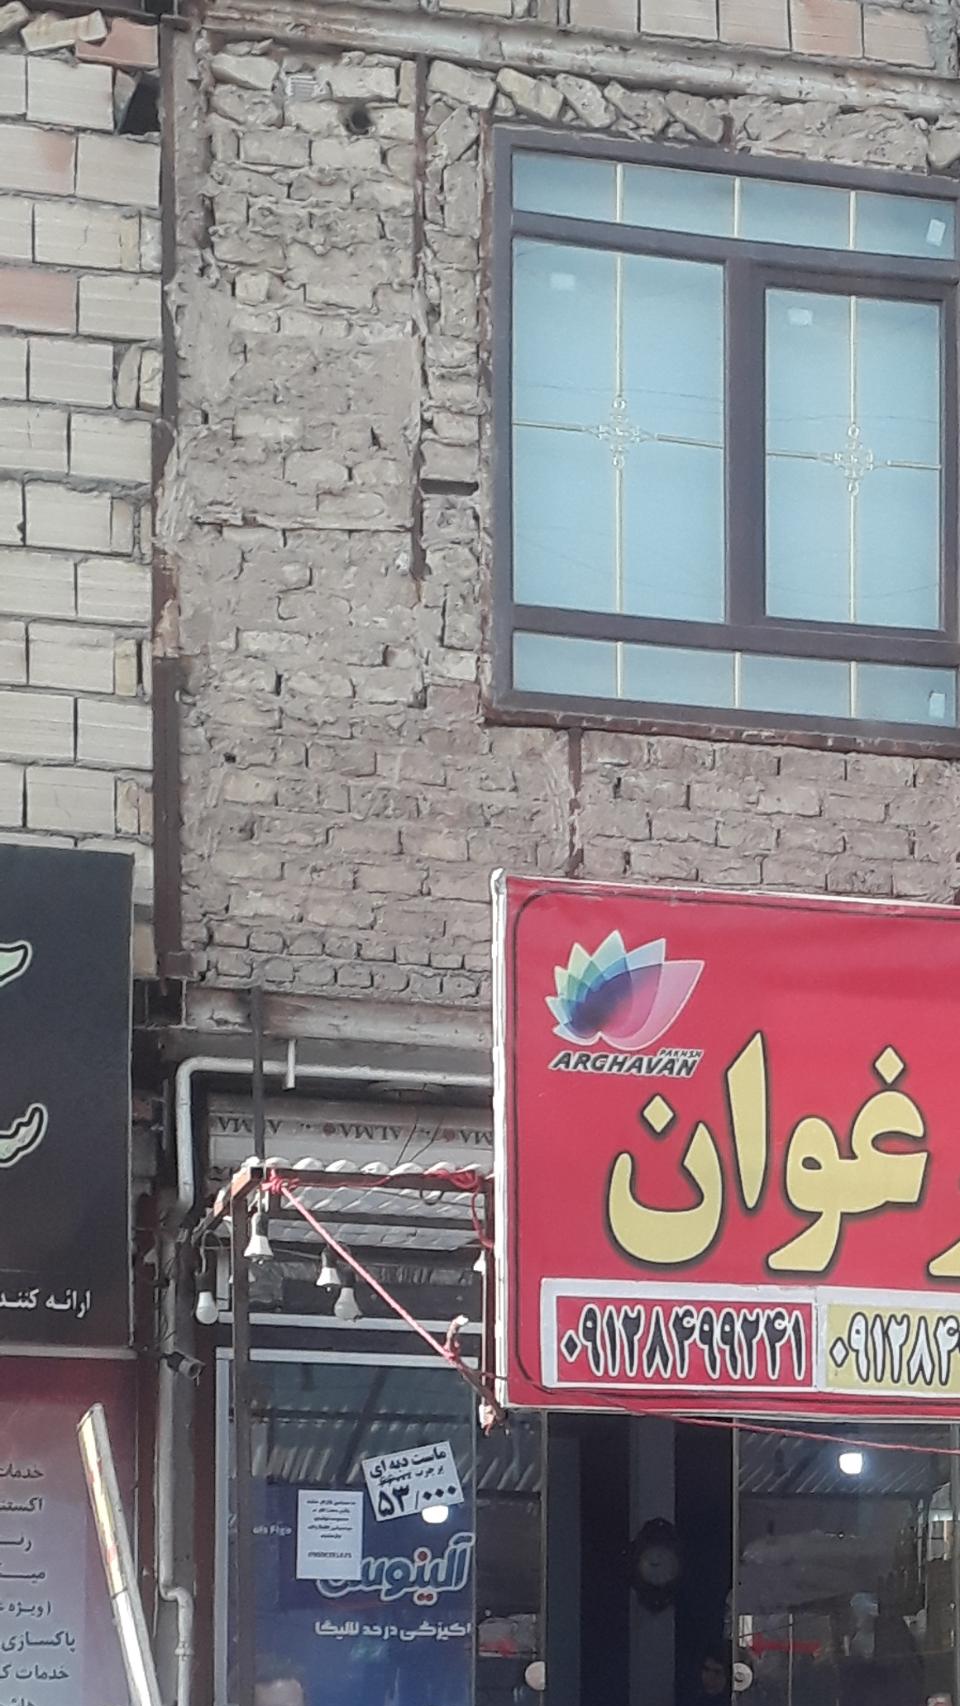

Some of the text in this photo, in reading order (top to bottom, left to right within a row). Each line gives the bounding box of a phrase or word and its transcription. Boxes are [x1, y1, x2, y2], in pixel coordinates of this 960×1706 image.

[551, 1051, 699, 1077] ARGHAVAN
[45, 1289, 91, 1318] ارائه
[560, 1304, 806, 1380] ۰۹۱۲۸۴۹۹۲۴۱
[411, 1447, 447, 1465] ماست
[1, 1630, 76, 1652] پاکسازی
[15, 1664, 69, 1680] خدمات
